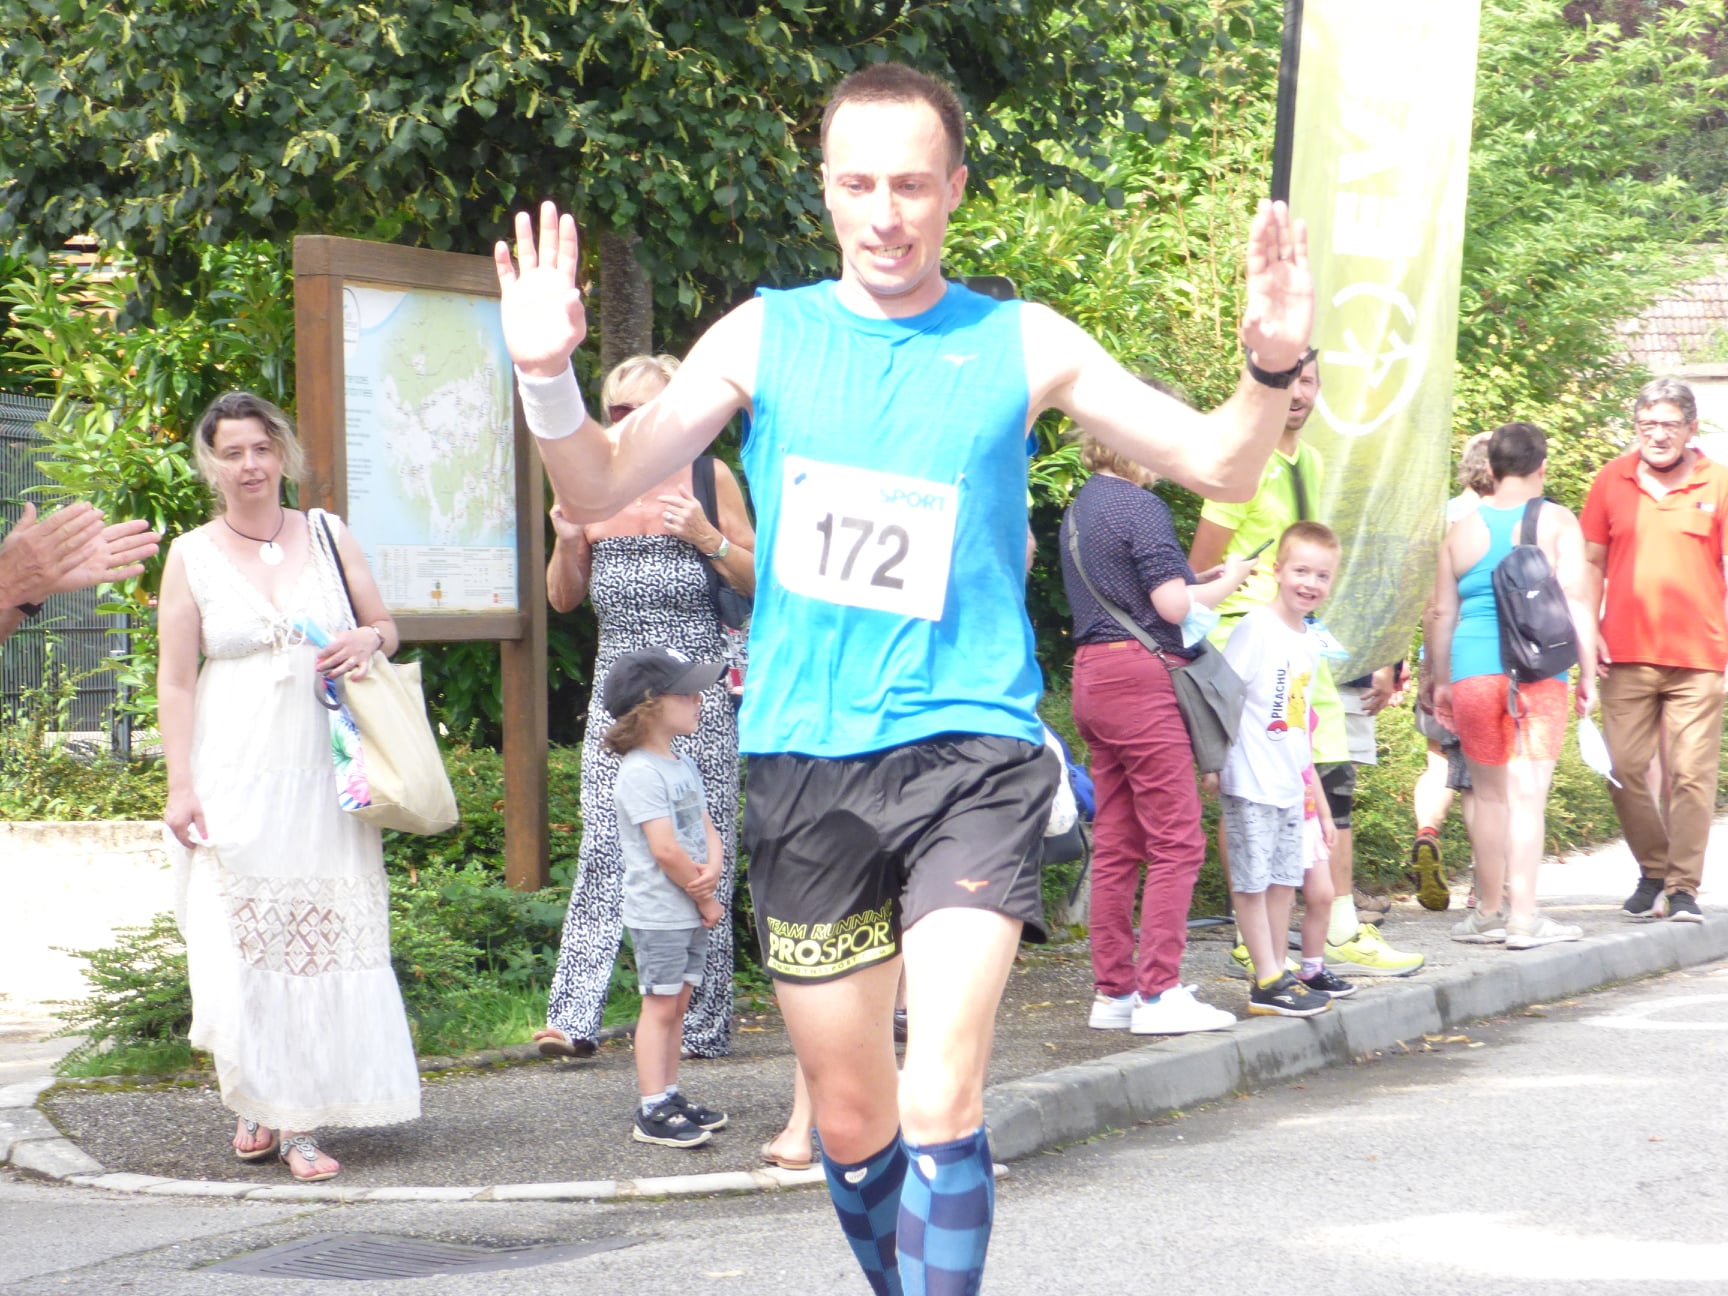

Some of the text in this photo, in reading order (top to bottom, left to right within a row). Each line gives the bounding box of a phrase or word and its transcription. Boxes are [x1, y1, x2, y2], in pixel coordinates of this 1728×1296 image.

[879, 487, 948, 512] SPORT
[816, 512, 910, 590] 172
[1271, 669, 1287, 719] PIKACHU
[767, 916, 807, 939] TEAM
[769, 921, 894, 966] PROSPOR
